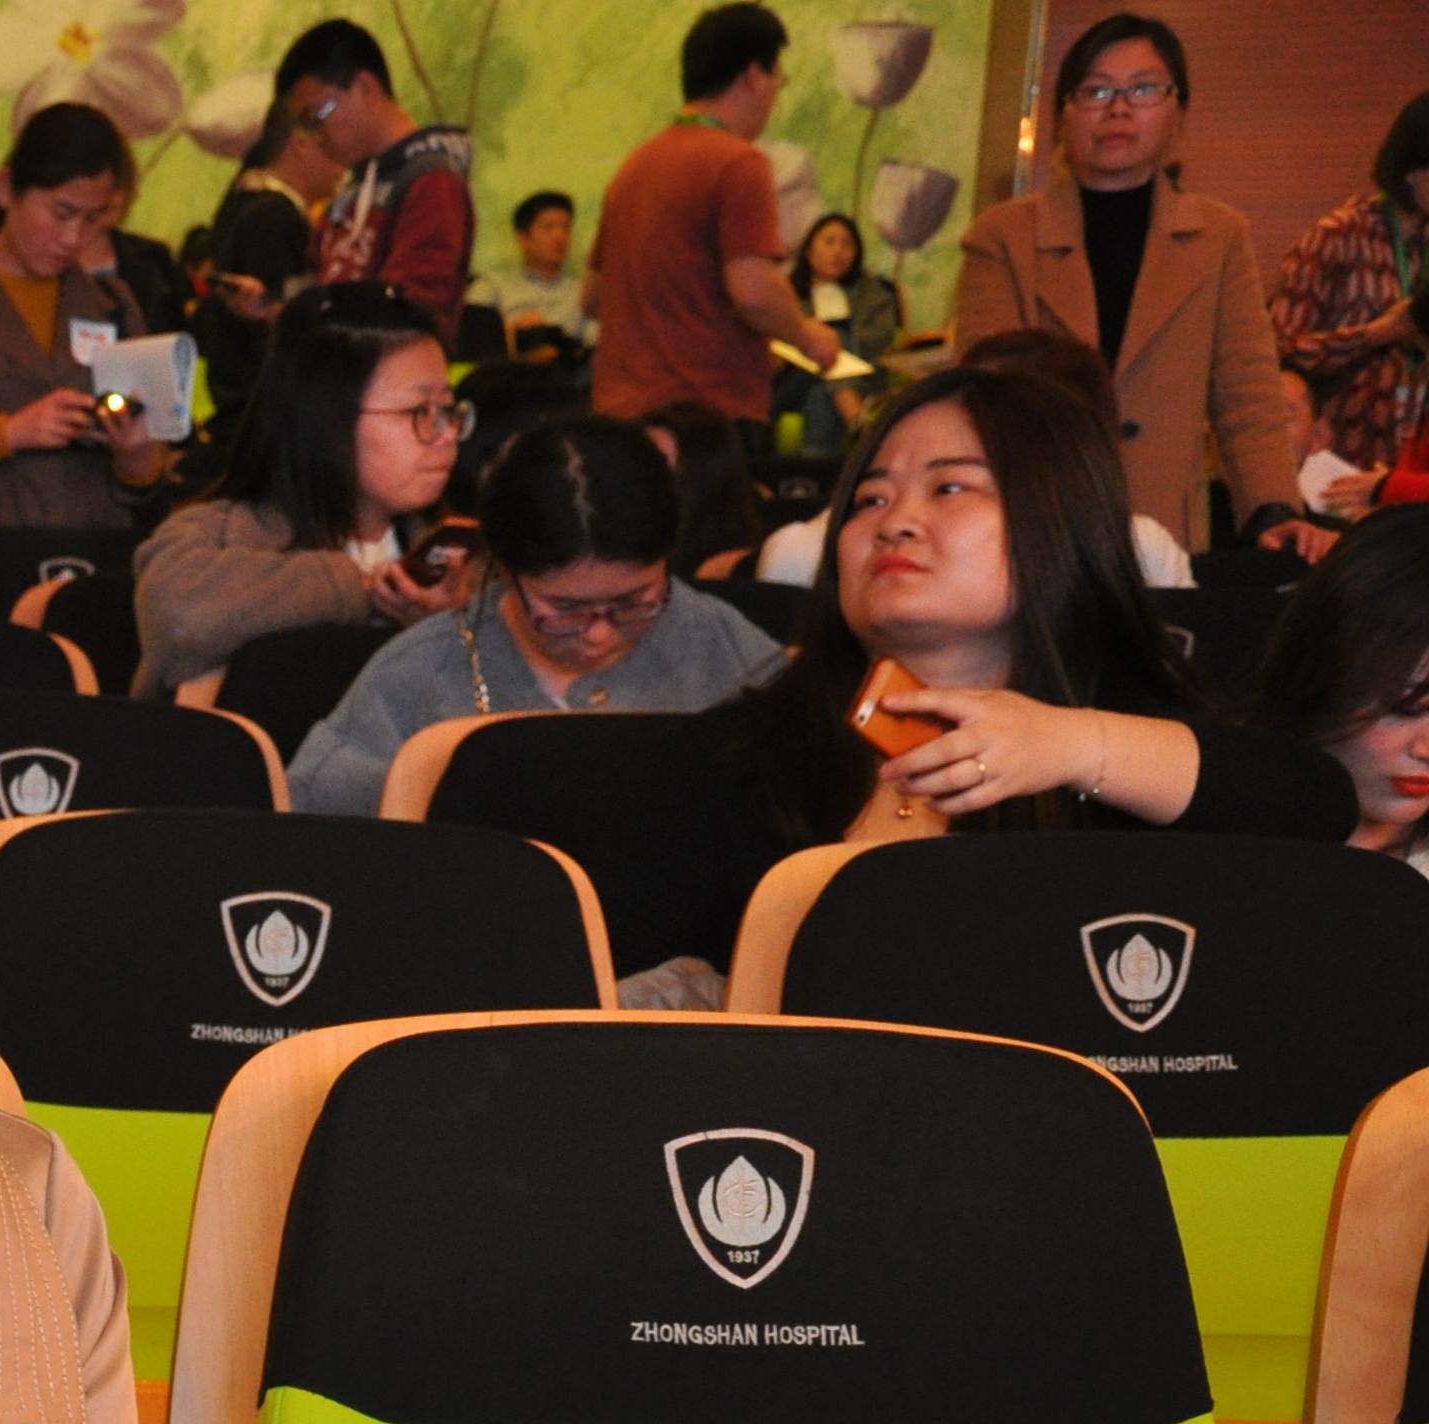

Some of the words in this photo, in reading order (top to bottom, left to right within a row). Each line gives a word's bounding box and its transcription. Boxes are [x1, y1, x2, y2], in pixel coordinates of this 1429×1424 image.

[191, 1023, 285, 1044] ZHONGSHAN
[1163, 1054, 1238, 1073] HOSPITAL
[727, 1249, 760, 1265] 1937
[630, 1321, 758, 1345] ZHONGSHAN
[764, 1323, 865, 1346] HOSPITAL
